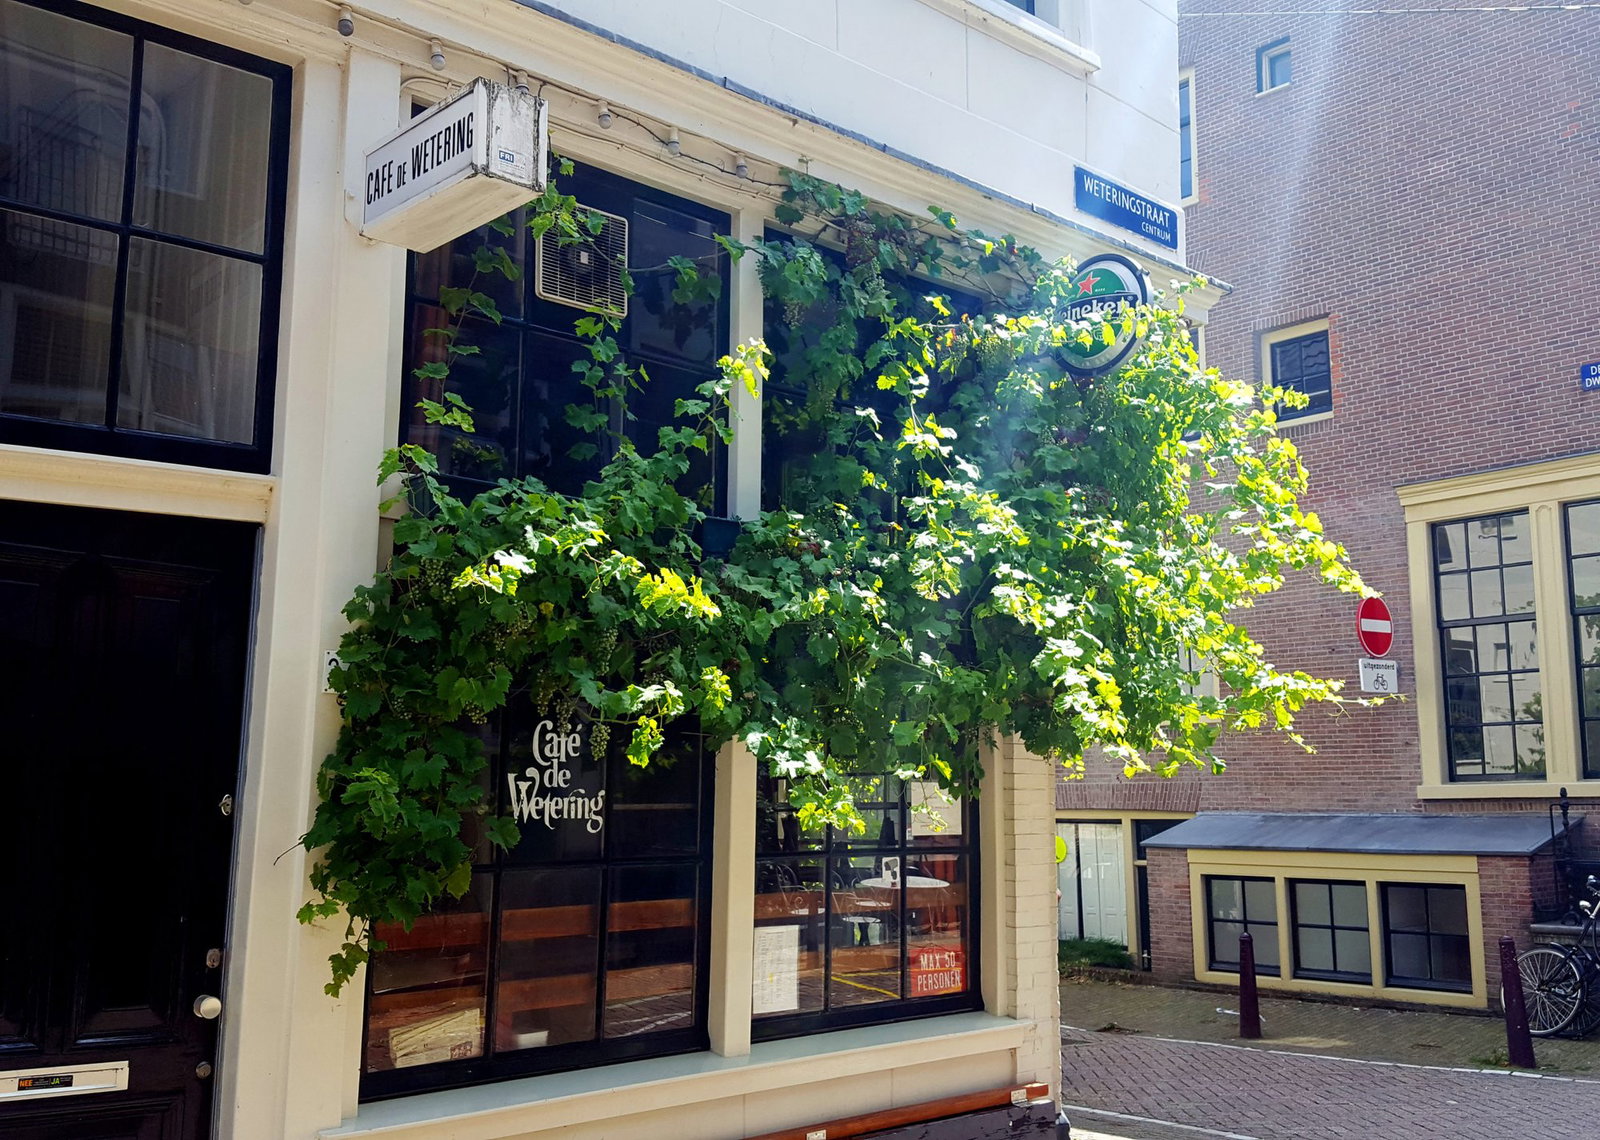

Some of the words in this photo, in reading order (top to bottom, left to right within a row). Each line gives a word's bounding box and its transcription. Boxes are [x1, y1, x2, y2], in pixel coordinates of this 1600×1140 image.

[366, 160, 394, 206] CAFE
[397, 161, 407, 189] DE
[411, 112, 474, 180] WETERING
[500, 152, 513, 162] FRI
[1083, 174, 1170, 228] WETERINGSTRAAT
[1141, 221, 1171, 242] CENTRUM
[1058, 299, 1131, 321] eineken
[1363, 662, 1395, 671] uitgezonderd
[532, 720, 583, 767] Café
[543, 758, 572, 788] de
[507, 767, 606, 834] Wetering
[920, 953, 940, 971] MAX
[917, 969, 961, 992] PERSONEN
[51, 1077, 60, 1085] JA
